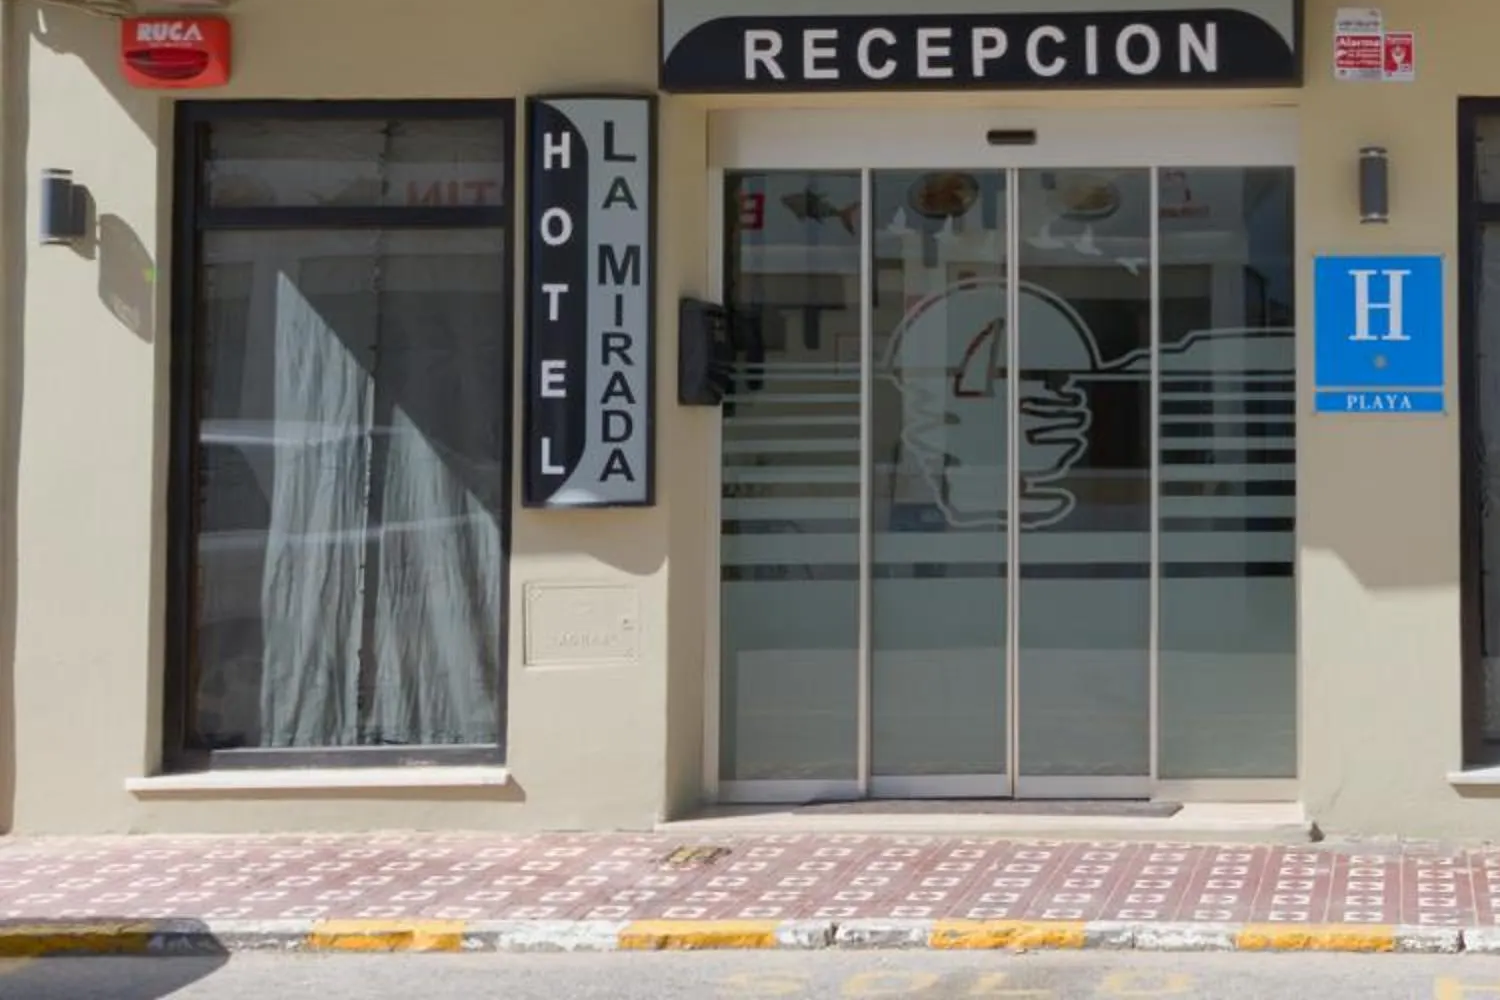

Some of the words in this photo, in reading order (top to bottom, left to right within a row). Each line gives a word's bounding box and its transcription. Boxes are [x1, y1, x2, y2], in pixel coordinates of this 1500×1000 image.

[136, 21, 203, 41] RUCA
[743, 22, 1219, 80] RECEPCION
[601, 119, 638, 212] LA
[540, 131, 574, 476] HOTEL
[1347, 268, 1412, 341] H
[597, 243, 642, 483] MIRADA
[1346, 394, 1412, 410] PLAYA
